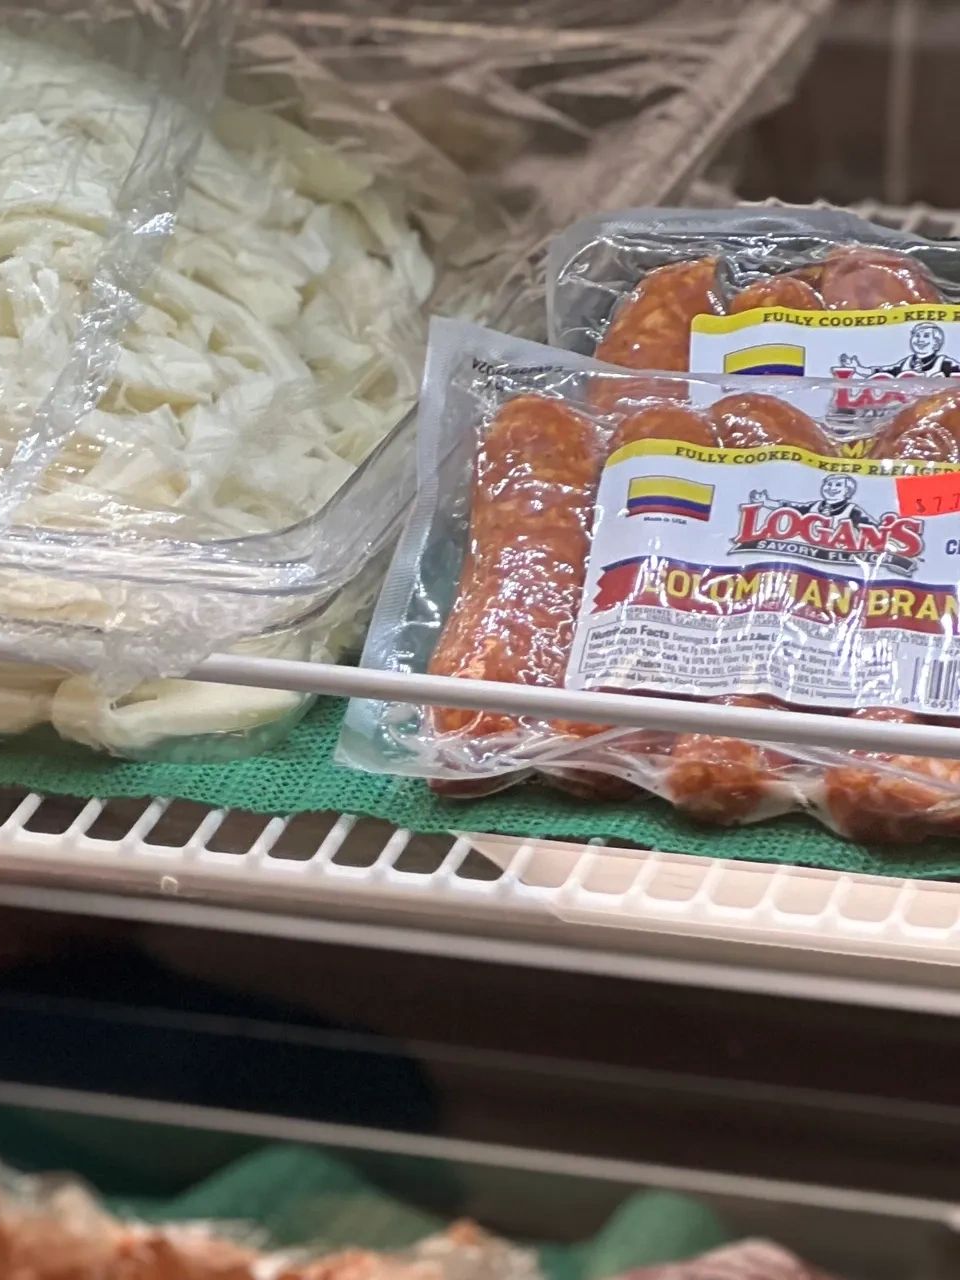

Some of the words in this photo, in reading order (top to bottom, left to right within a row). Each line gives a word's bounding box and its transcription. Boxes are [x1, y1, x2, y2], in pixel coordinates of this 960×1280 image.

[763, 312, 813, 327] FULLY
[819, 315, 887, 327] COOKED
[904, 310, 947, 322] KEEP
[675, 446, 727, 463] FULLY
[733, 449, 802, 464] COOKED
[818, 460, 862, 473] KEEP
[735, 501, 925, 560] LOGAN'S
[757, 539, 819, 557] SAVORY
[644, 568, 852, 614] OLOMIAN
[590, 626, 637, 640] Nutriton
[640, 625, 669, 639] Facts
